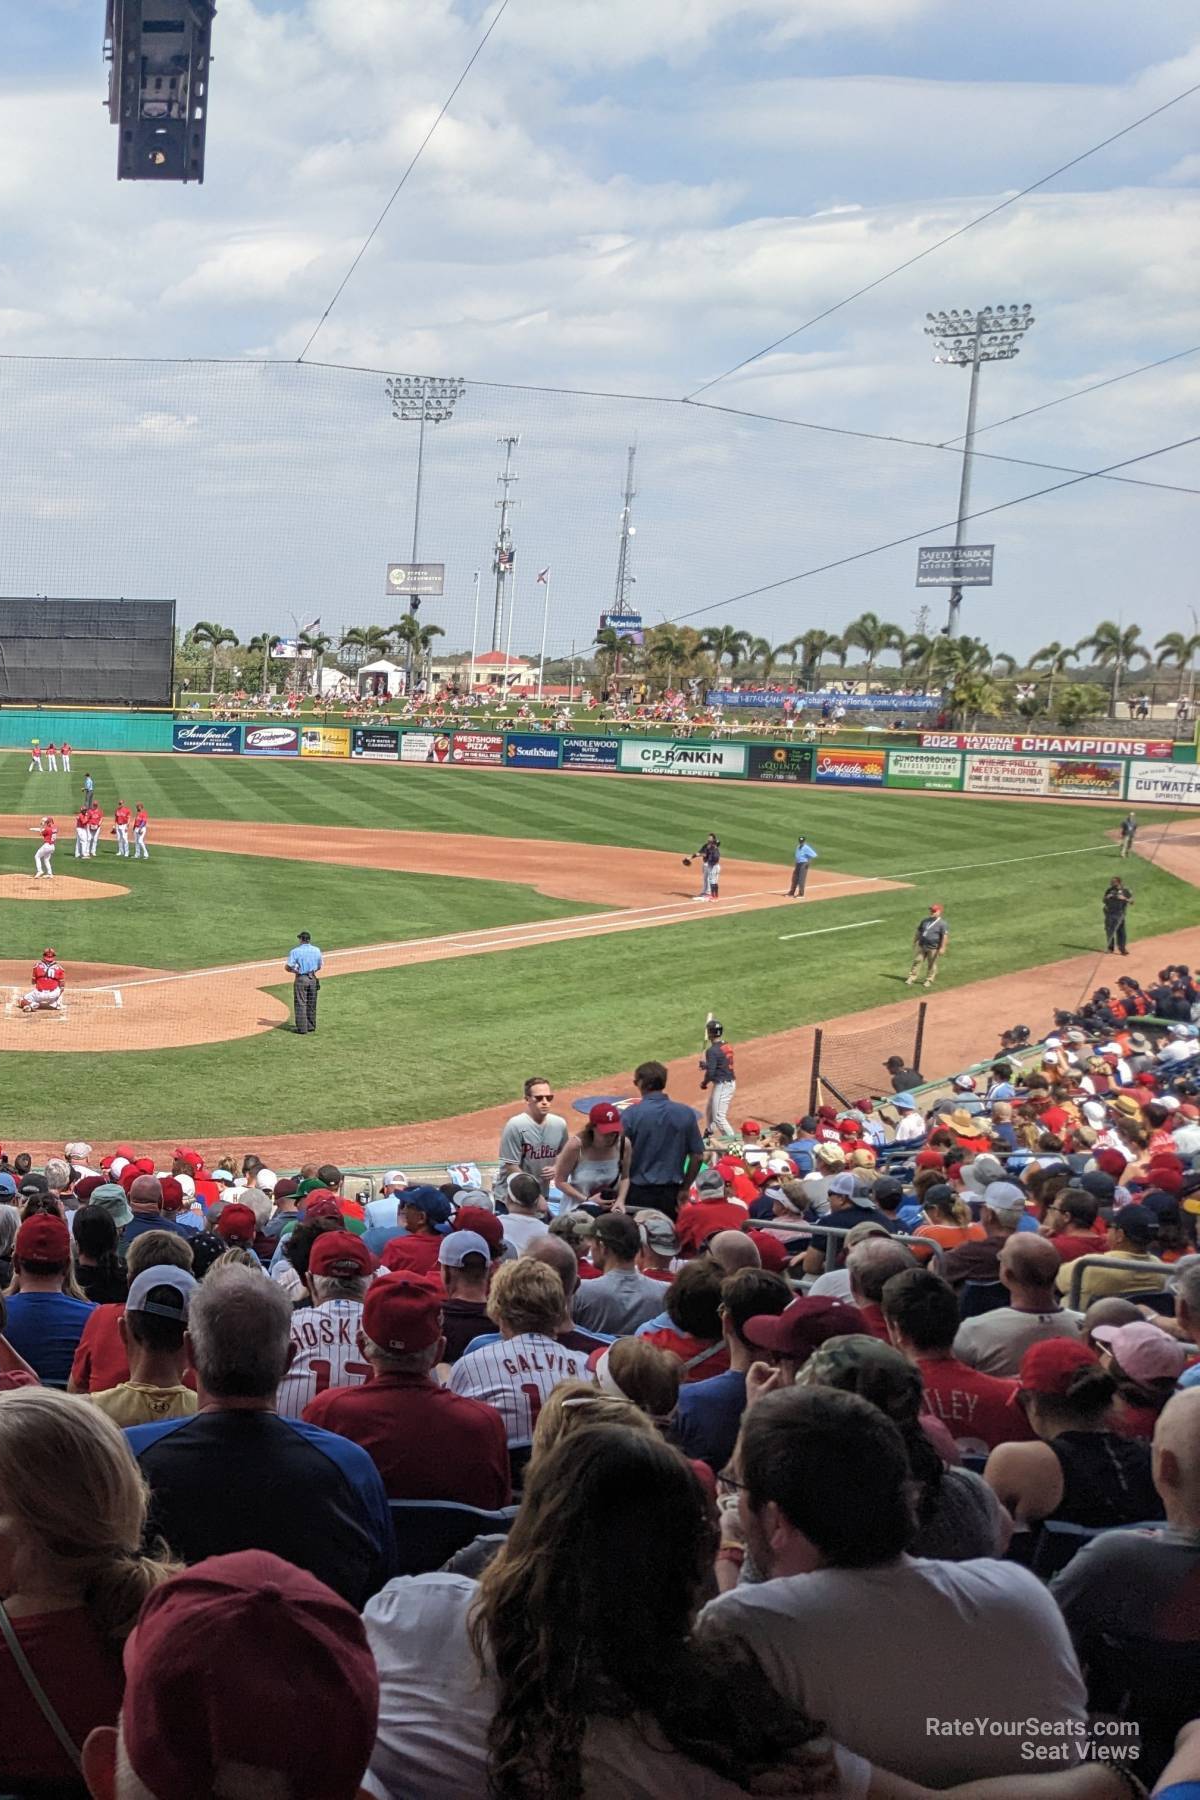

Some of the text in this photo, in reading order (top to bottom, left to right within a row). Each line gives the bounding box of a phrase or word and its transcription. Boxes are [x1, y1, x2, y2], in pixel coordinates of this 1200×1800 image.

[921, 549, 992, 559] SAFETY HARBOR
[178, 725, 237, 744] Sandpearl
[457, 735, 502, 744] WESTSHORE
[563, 740, 618, 748] CANDLEWOOD
[922, 735, 1017, 748] 2022 NATIONAL
[467, 743, 489, 751] PIZZA
[517, 747, 558, 757] SouthState
[966, 743, 1014, 751] LEAGUE
[1021, 738, 1146, 756] CHAMPIONS
[640, 749, 724, 764] CP-RANKIN
[899, 755, 957, 764] UNDERGROUND
[816, 757, 865, 775] Surfside
[979, 759, 1007, 767] WHERE
[642, 767, 720, 777] ROOFING EXPERTS
[971, 766, 1042, 776] MEETS PHLORIDA
[1054, 778, 1115, 788] HIDEAWAY
[1135, 780, 1200, 793] CUTWATER
[522, 1143, 561, 1160] Phillie
[503, 1352, 578, 1376] GALVIS
